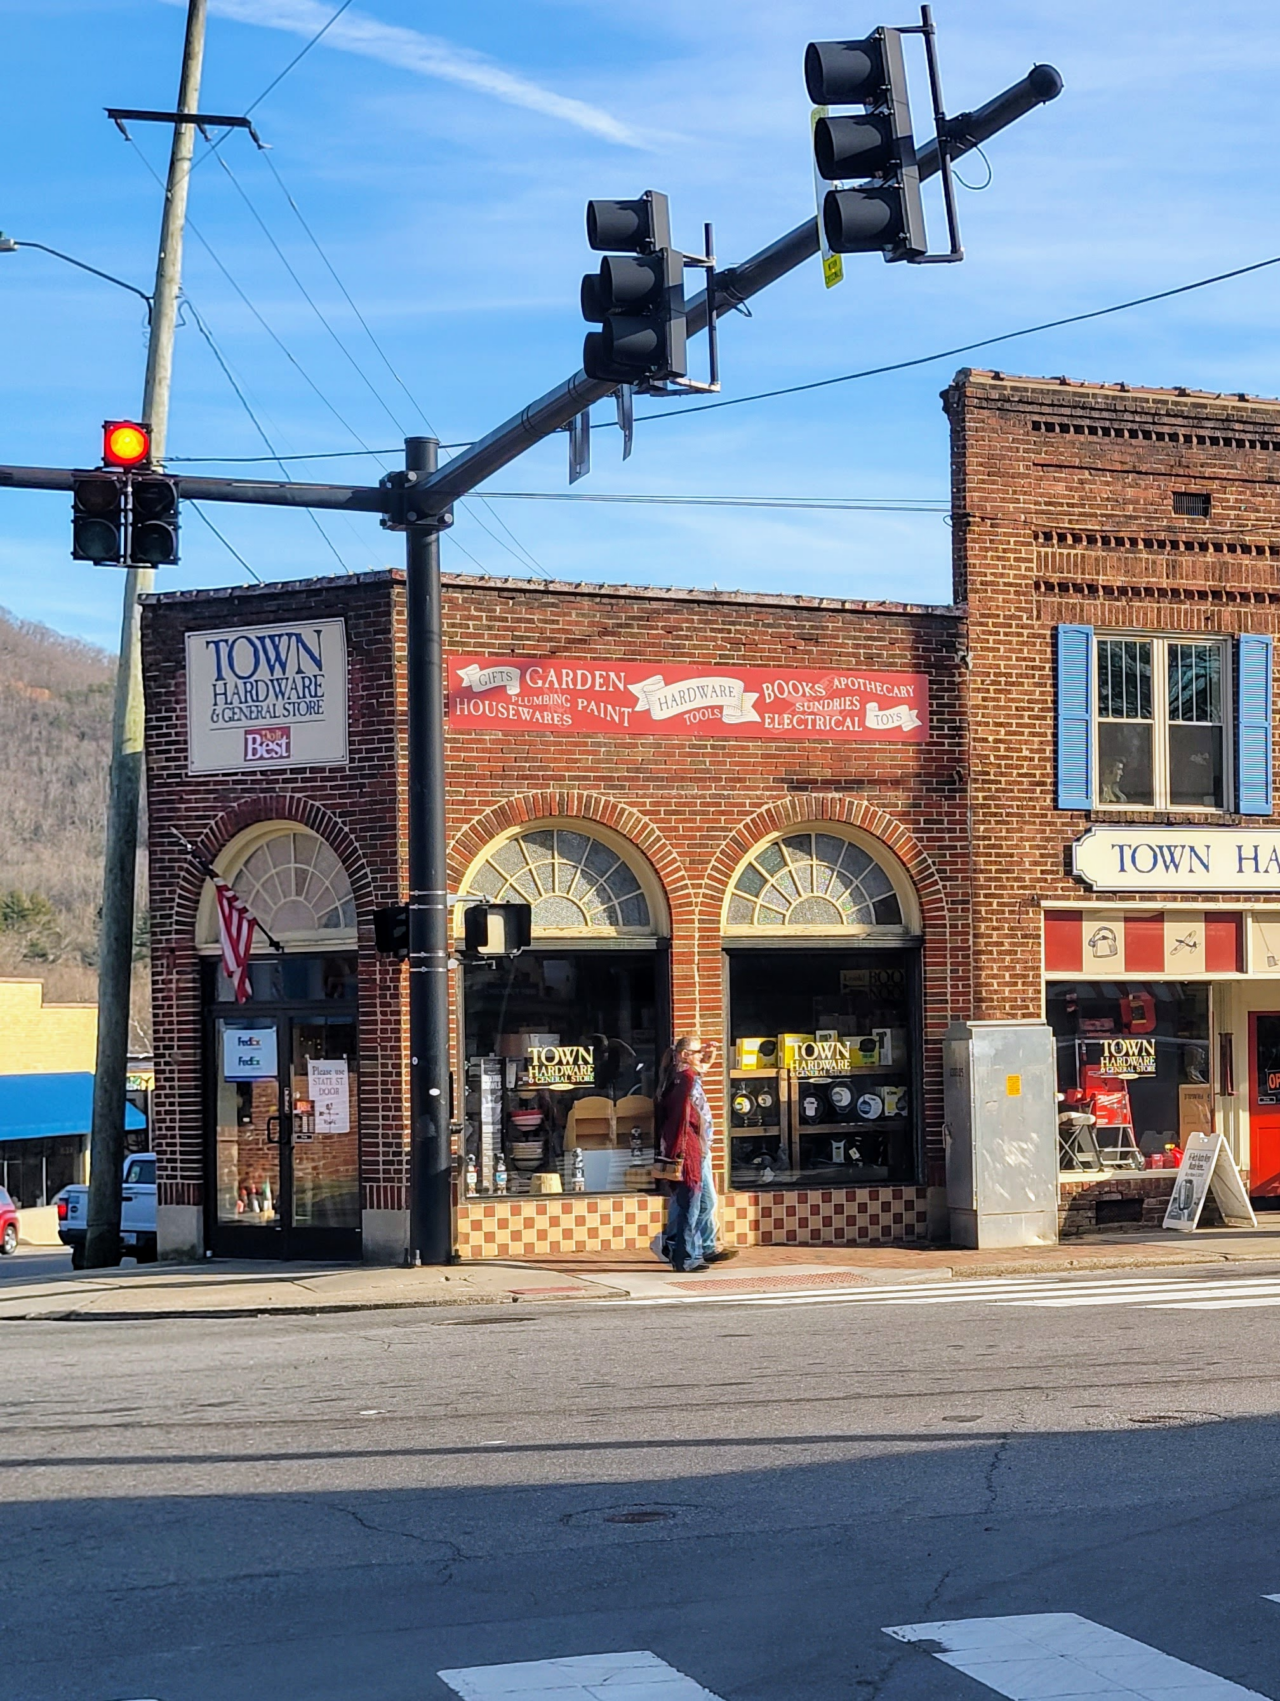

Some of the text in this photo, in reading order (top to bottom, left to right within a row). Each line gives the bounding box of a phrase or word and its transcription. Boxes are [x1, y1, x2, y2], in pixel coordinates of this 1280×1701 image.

[206, 629, 323, 682] TOWN
[479, 671, 513, 687] GIFTS
[526, 667, 625, 692] GARDEN
[833, 677, 915, 698] APOTHECARY
[212, 674, 325, 706] HARDWARE
[658, 685, 736, 711] HARDWARE
[762, 680, 826, 704] BOOKS
[511, 694, 571, 707] PLUMBING
[795, 696, 860, 713] SUNDRIES
[210, 700, 324, 723] & GENERAL STORE
[456, 698, 572, 726] HOUSEWARES
[577, 698, 632, 727] PAINT
[684, 709, 721, 726] TOOLS
[874, 712, 902, 726] TOYS
[764, 713, 862, 731] ELECTRICAL
[246, 734, 289, 760] Best
[1111, 843, 1211, 874] TOWN
[237, 1036, 261, 1047] FedEx
[1100, 1039, 1156, 1057] TOWN
[528, 1046, 594, 1066] TOWN
[792, 1042, 851, 1060] TOWN
[238, 1056, 261, 1067] FedEx
[528, 1064, 595, 1077] HARDWARE
[790, 1059, 851, 1071] HARDWARE
[1100, 1056, 1156, 1067] HARDWARE
[312, 1066, 332, 1076] Please
[312, 1077, 333, 1086] STATE
[318, 1087, 340, 1096] DOOR
